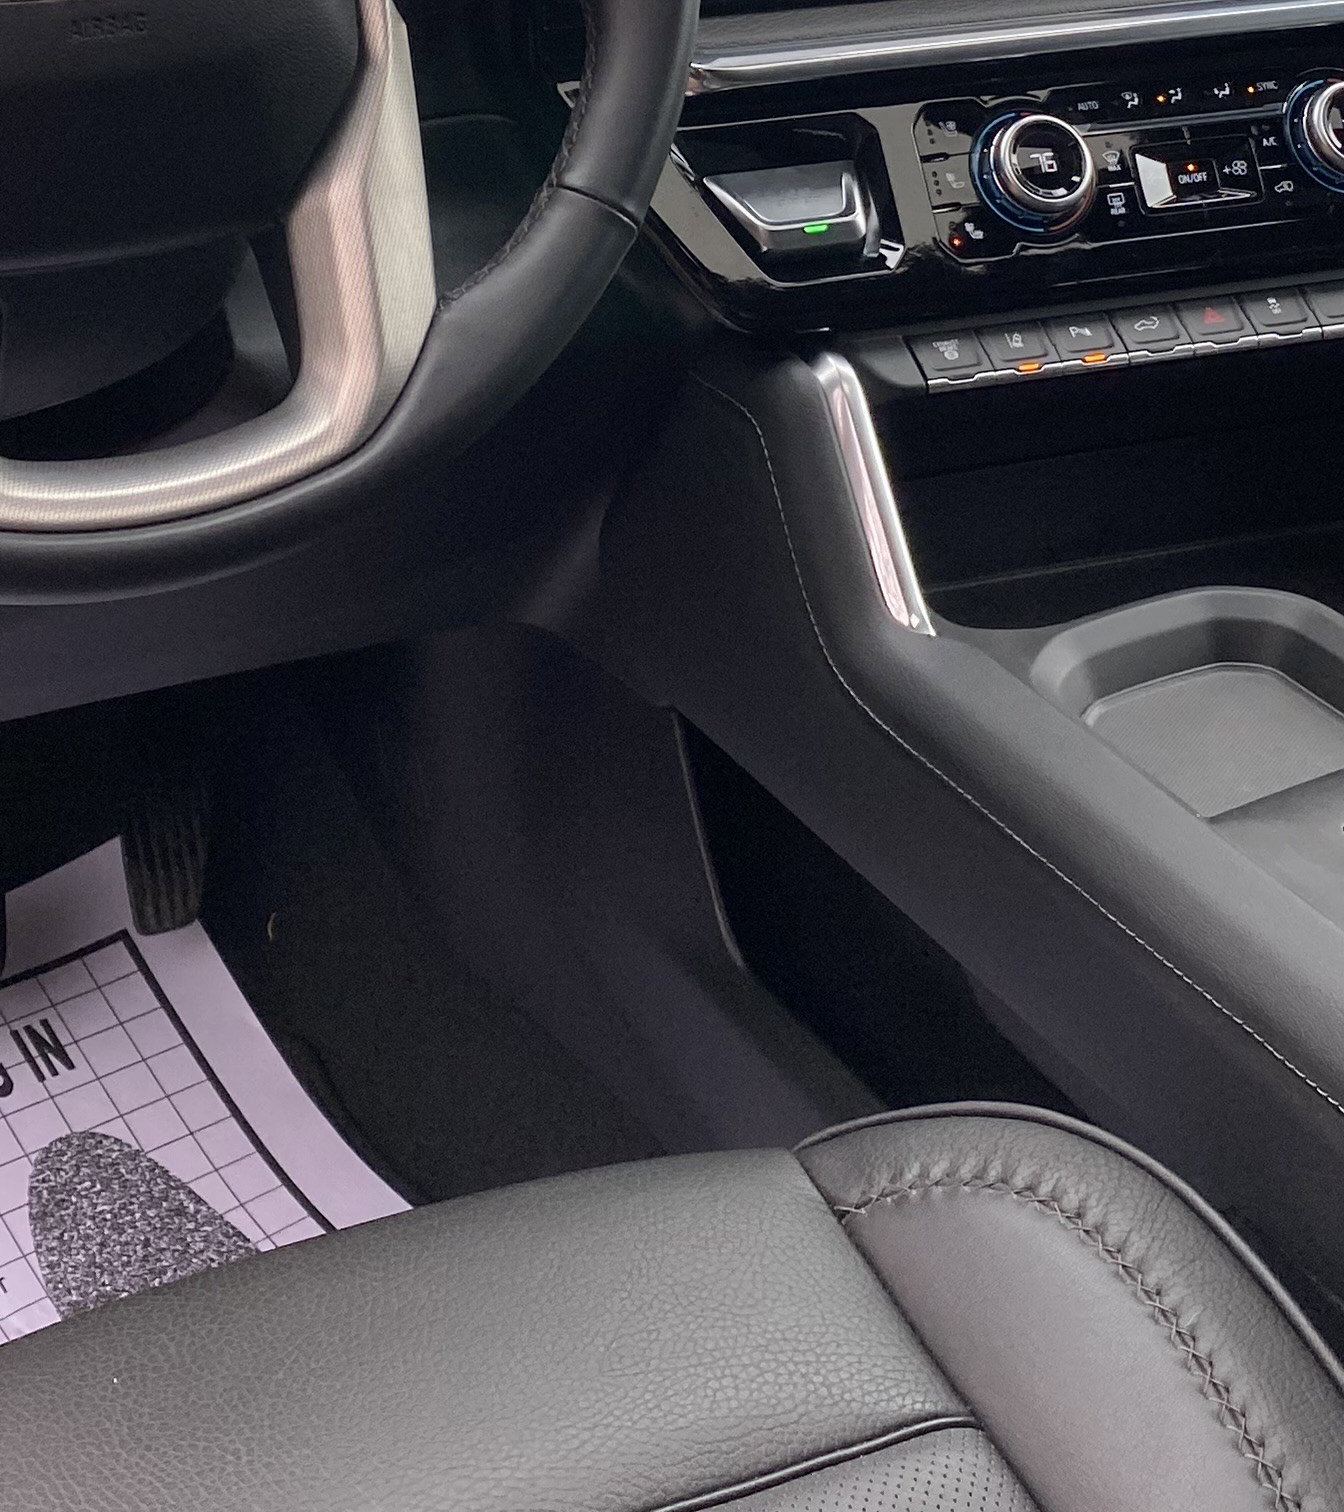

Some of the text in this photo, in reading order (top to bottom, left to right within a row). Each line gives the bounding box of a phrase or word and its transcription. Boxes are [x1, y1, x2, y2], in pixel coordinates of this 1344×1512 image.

[1077, 100, 1100, 112] AUTO
[1029, 151, 1058, 174] 76
[1178, 172, 1208, 185] ON/OFF
[9, 1018, 77, 1084] IN
